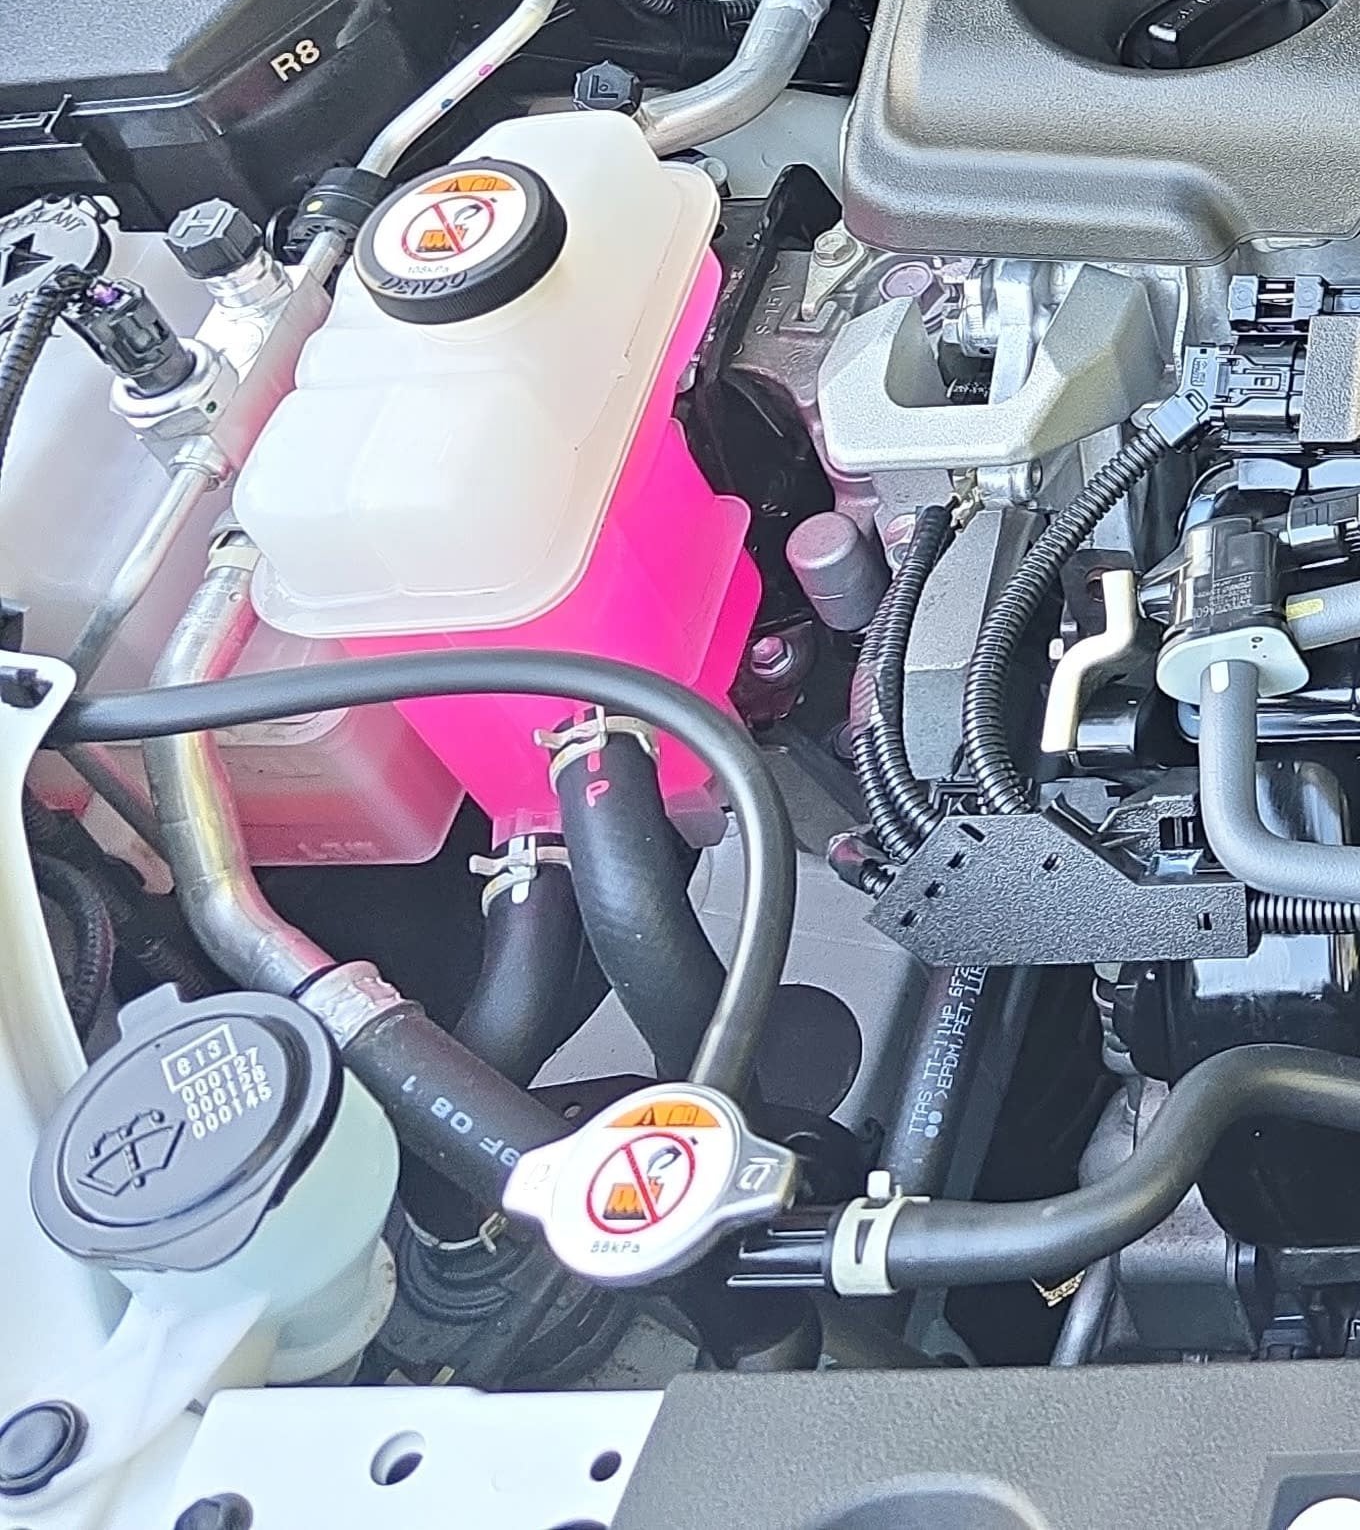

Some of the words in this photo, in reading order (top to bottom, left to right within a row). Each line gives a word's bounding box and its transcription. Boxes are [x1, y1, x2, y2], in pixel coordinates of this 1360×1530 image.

[270, 38, 321, 83] R8
[0, 210, 87, 232] OOLANT
[176, 208, 227, 238] H
[378, 270, 467, 295] DENSO
[181, 1047, 258, 1104] 000127
[431, 1096, 473, 1135] 08
